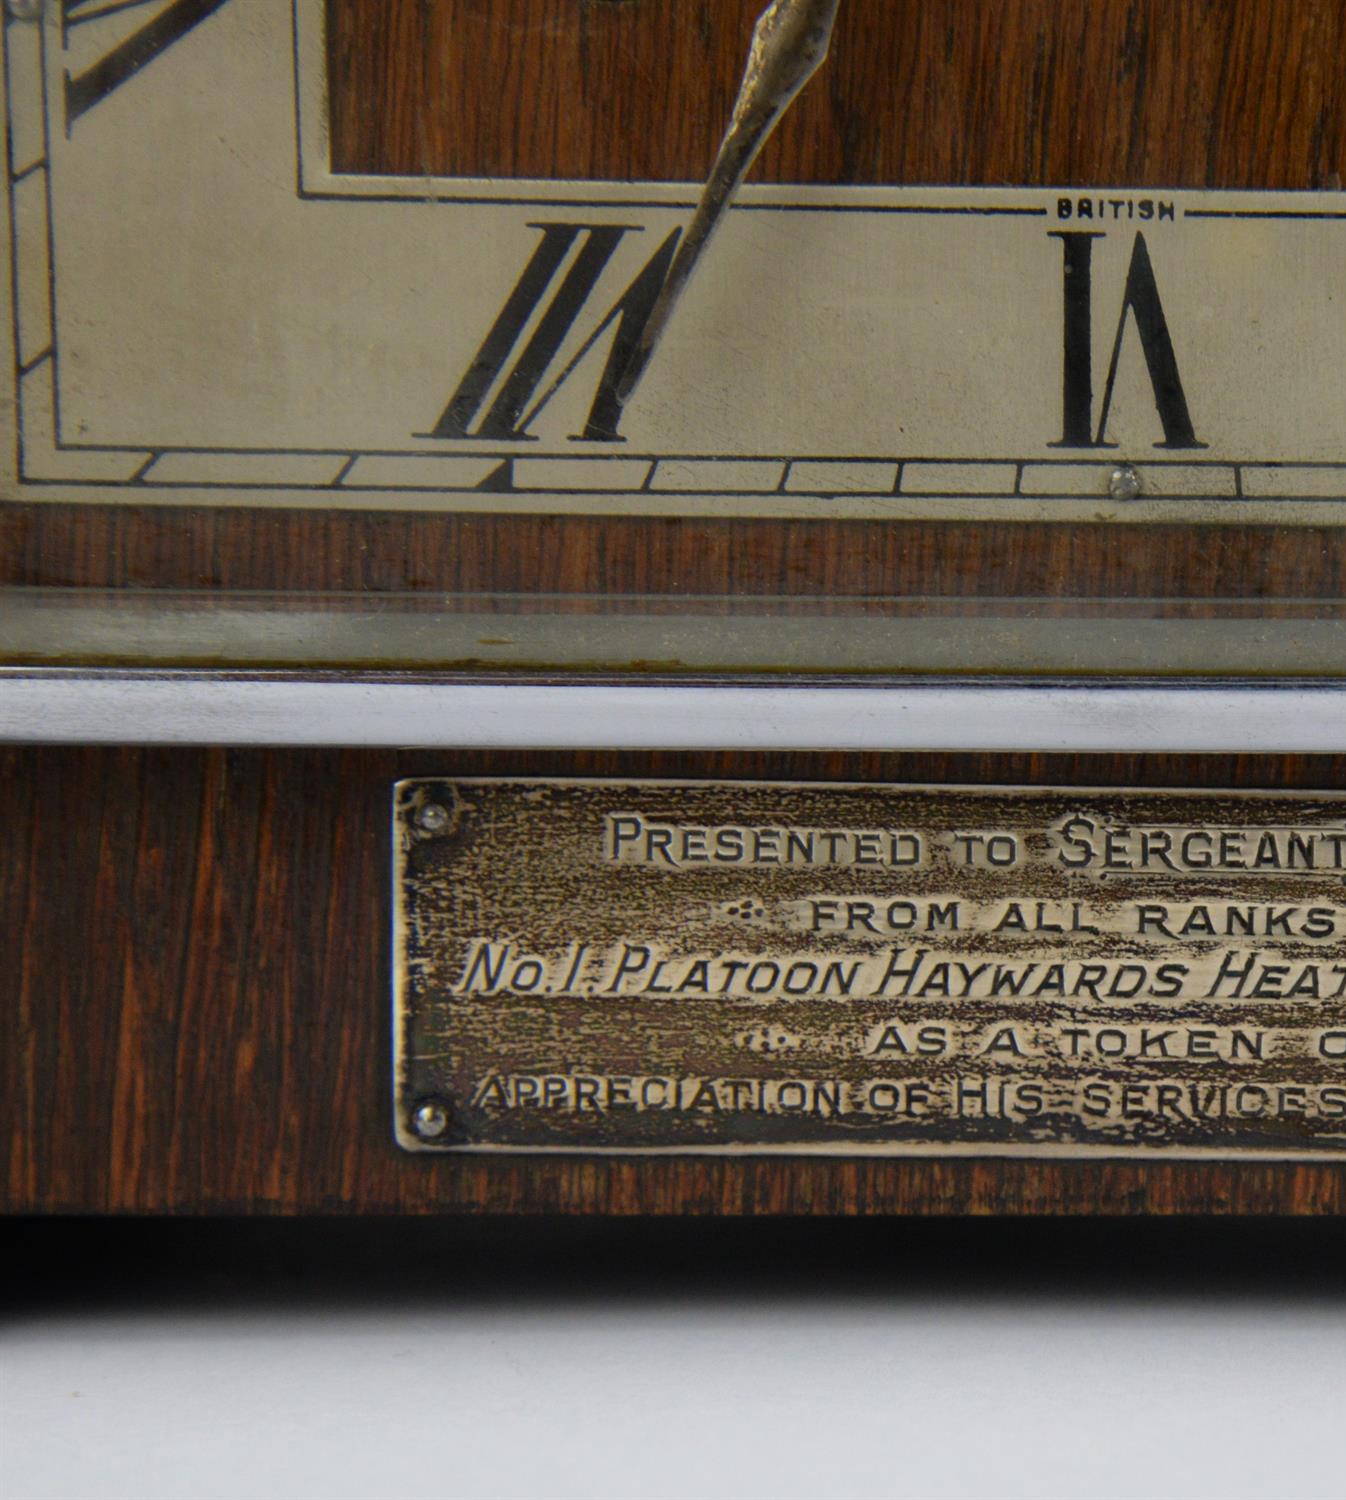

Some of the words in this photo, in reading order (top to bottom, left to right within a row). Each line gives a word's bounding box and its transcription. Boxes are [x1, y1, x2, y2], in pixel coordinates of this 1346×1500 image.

[1057, 198, 1174, 221] BRITISH
[610, 815, 921, 866] PRESENTED
[956, 834, 1018, 866] TO
[812, 902, 957, 932] FROM
[997, 902, 1099, 934] ALL
[1138, 905, 1336, 940] RANKS
[600, 943, 862, 997] PLATOON
[873, 949, 1187, 1002] HAYWARDS
[873, 1026, 948, 1056] AS
[980, 1027, 1024, 1057] A
[1062, 1028, 1266, 1060] TOKEN
[470, 1076, 841, 1116] APPRECIATION
[868, 1081, 930, 1113] OF
[956, 1080, 1044, 1116] HIS
